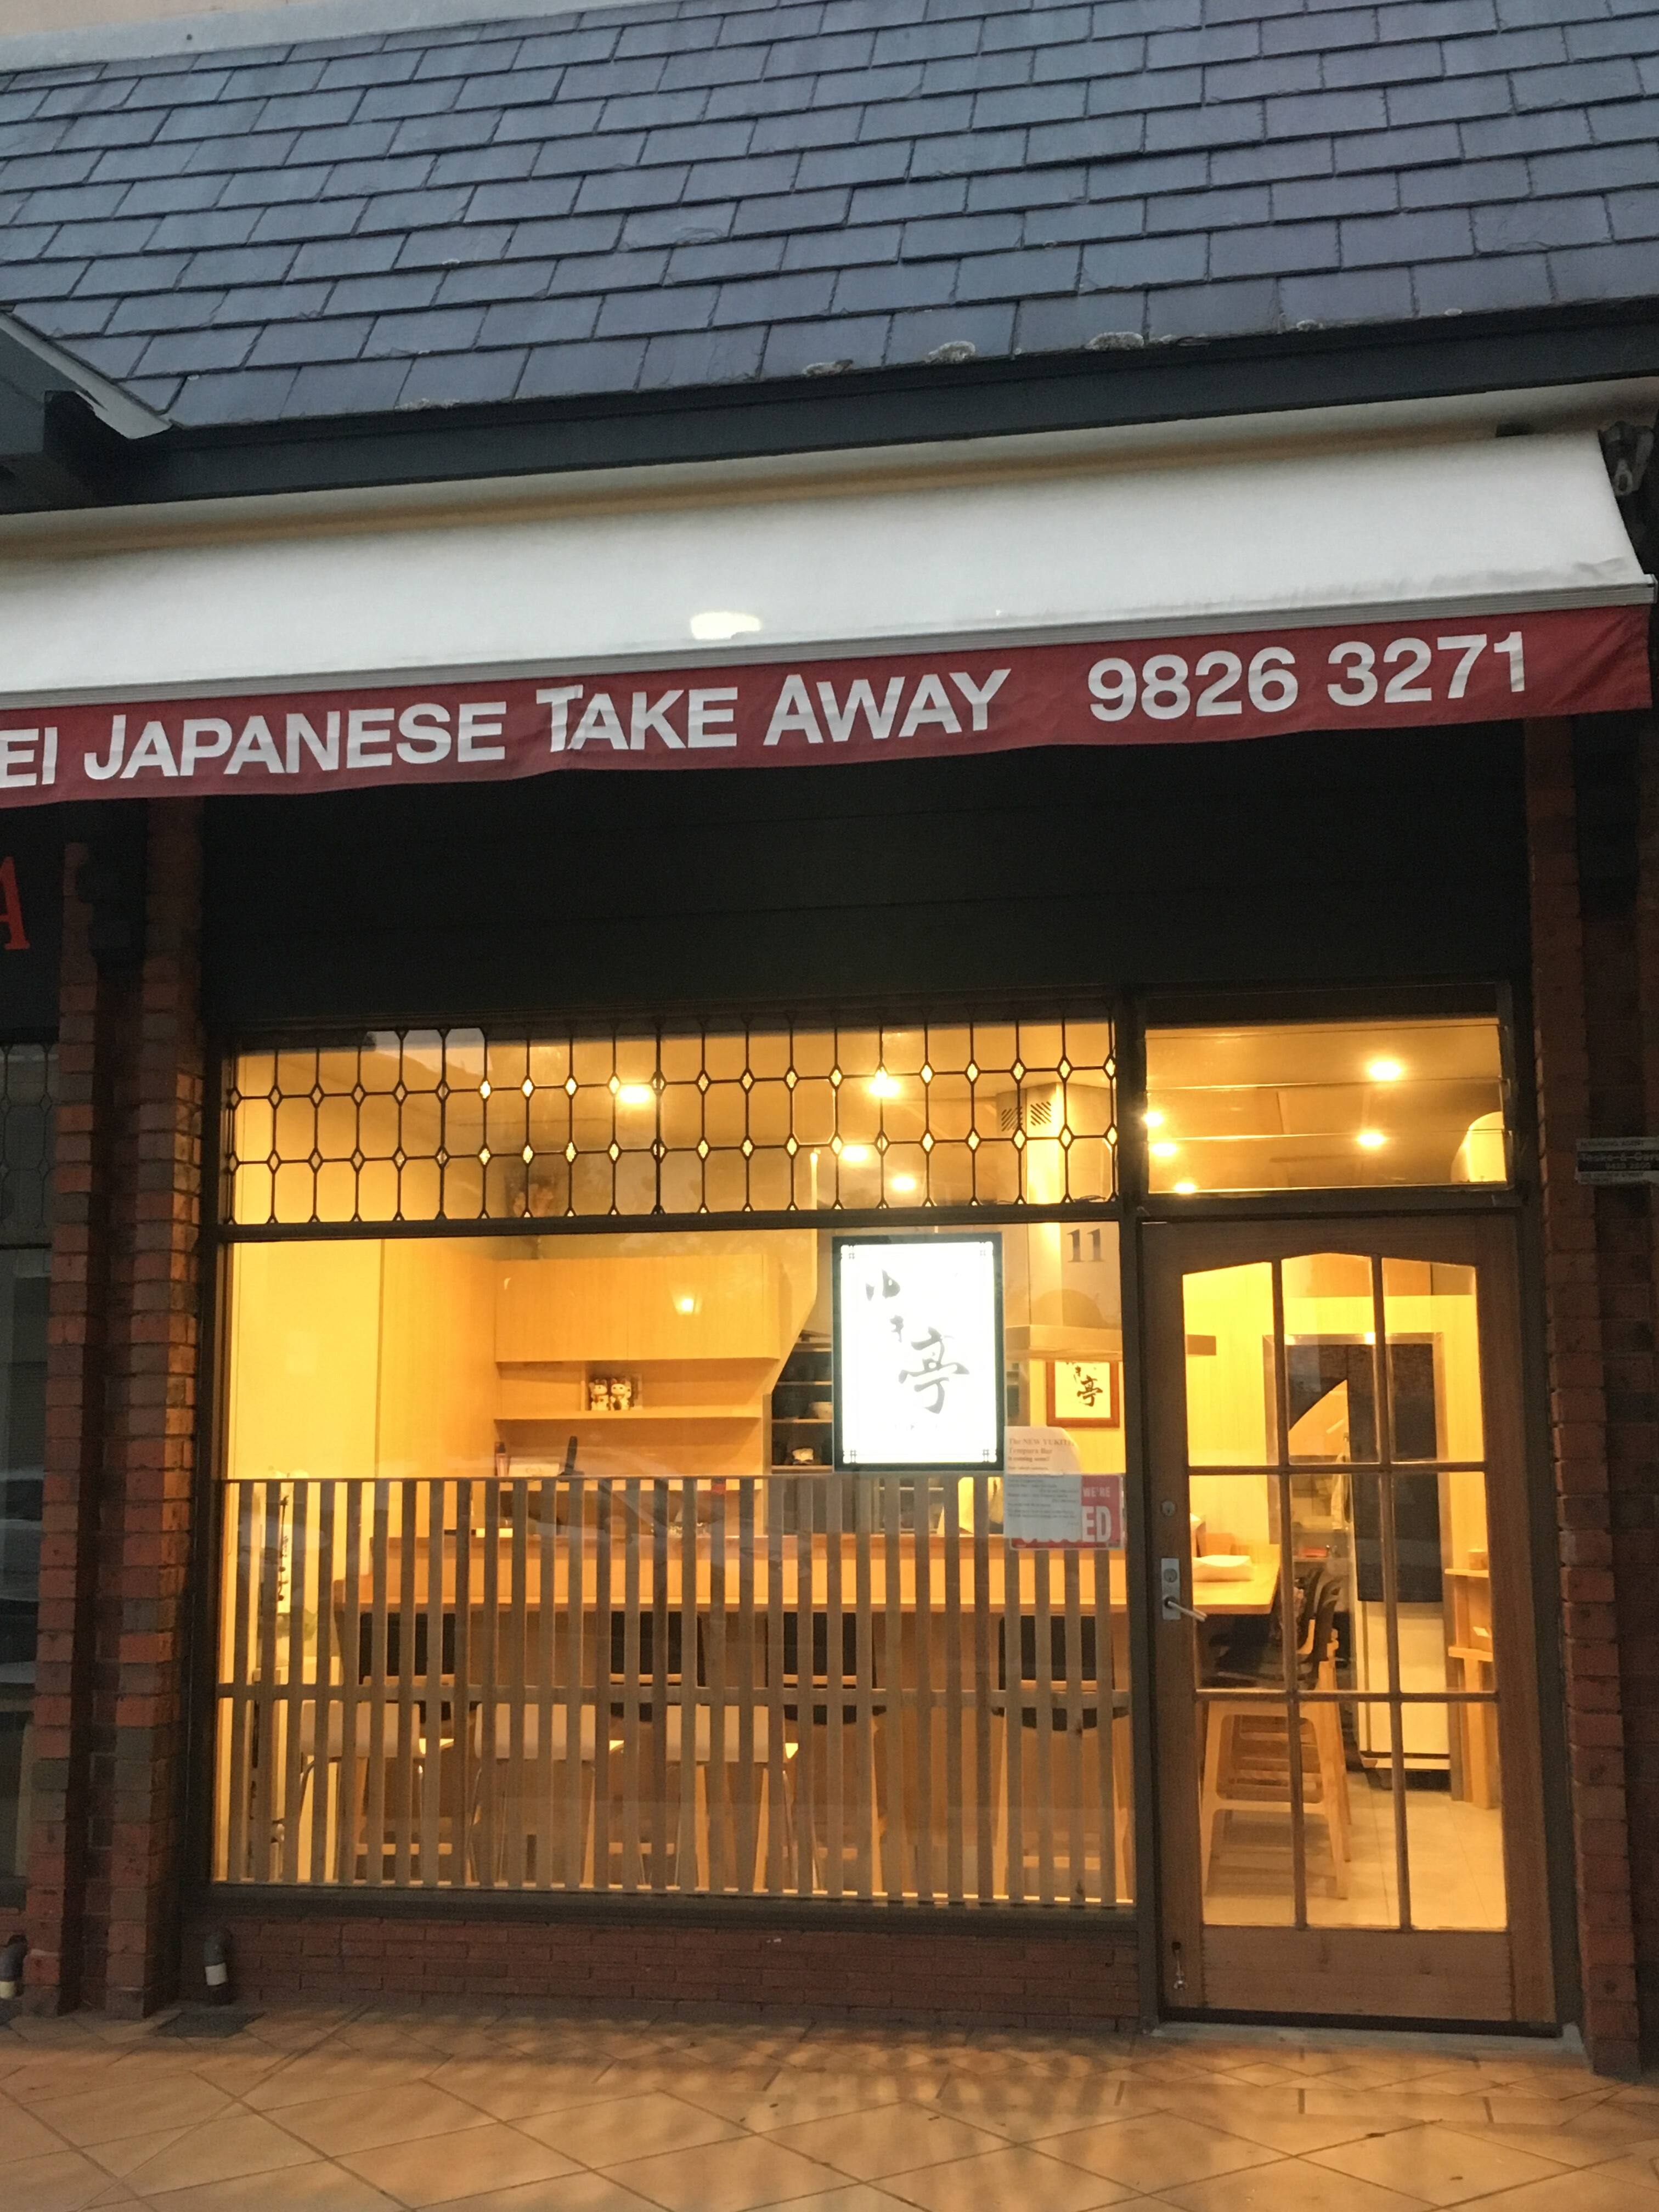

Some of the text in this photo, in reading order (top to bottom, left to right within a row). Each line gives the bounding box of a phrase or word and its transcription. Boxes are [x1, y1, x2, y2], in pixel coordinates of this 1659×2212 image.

[84, 701, 507, 780] JAPANESE
[535, 684, 738, 753] TAKE
[763, 668, 1012, 746] AWAY
[1087, 647, 1299, 722] 9826
[1327, 631, 1526, 707] 3271
[1066, 1228, 1106, 1262] 11
[1083, 1486, 1110, 1497] WE'RE
